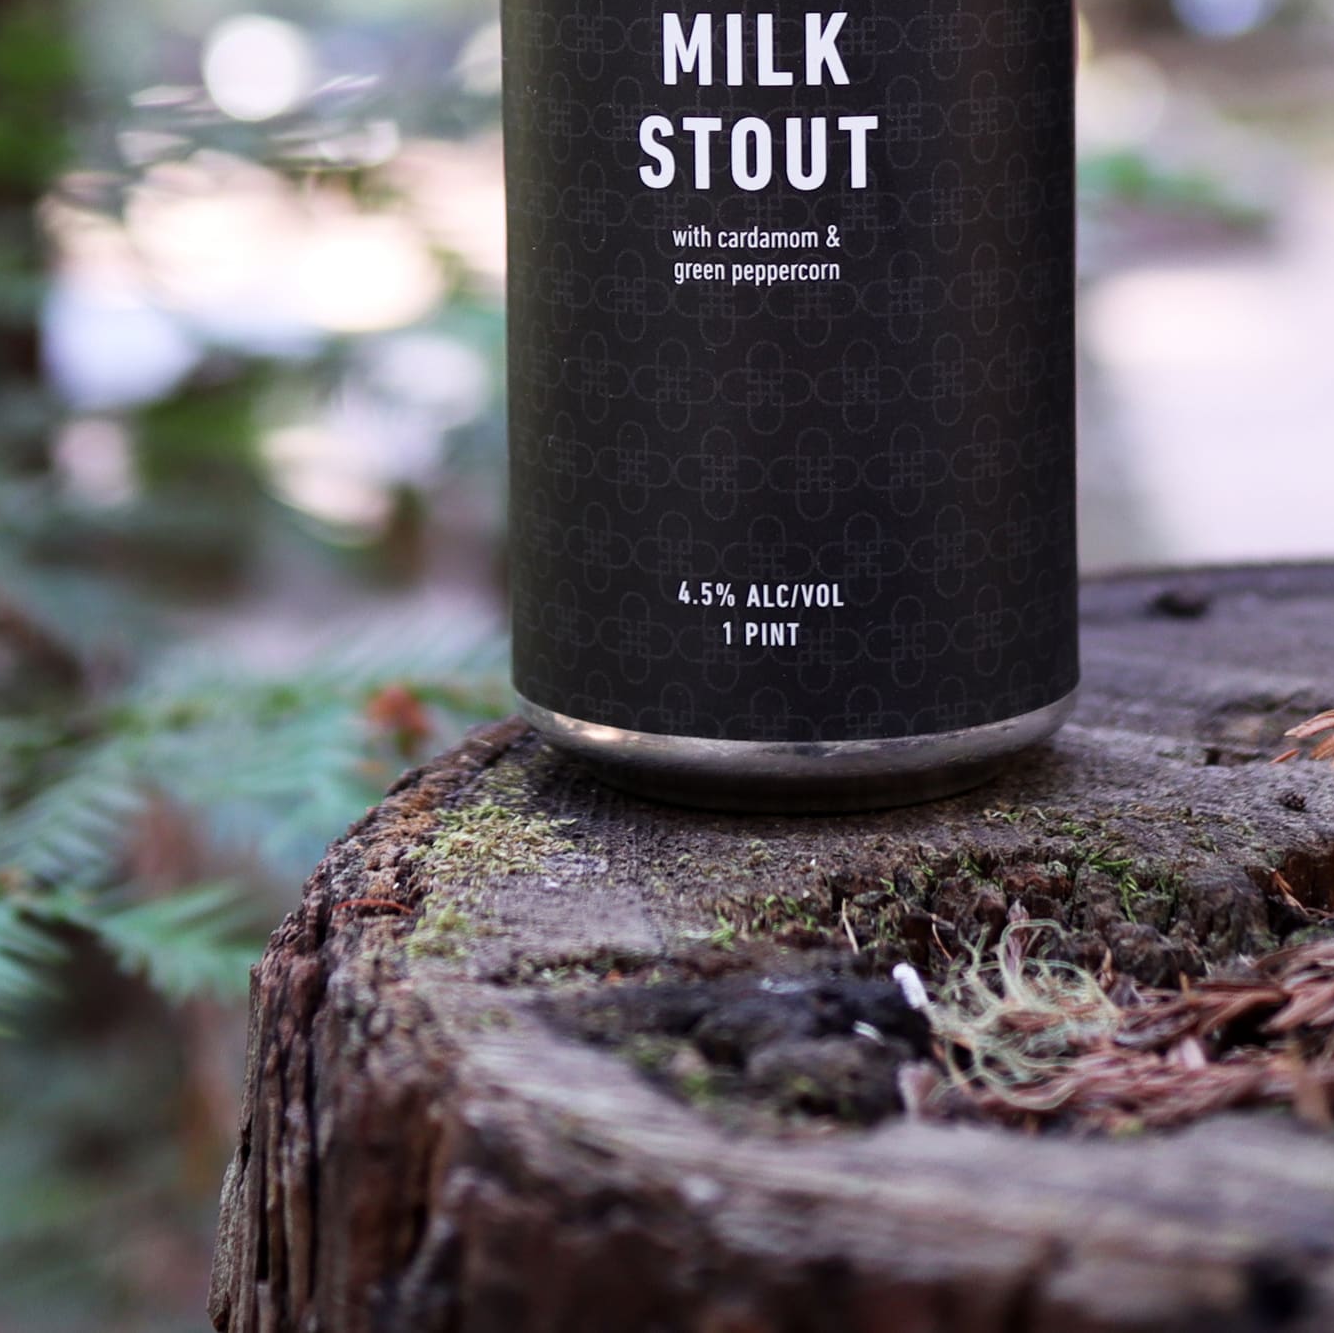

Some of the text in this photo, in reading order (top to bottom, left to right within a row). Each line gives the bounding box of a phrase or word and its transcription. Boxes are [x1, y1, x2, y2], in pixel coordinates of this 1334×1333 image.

[662, 11, 851, 87] MILK
[638, 114, 879, 192] STOUT
[672, 225, 841, 249] with cardamom &
[674, 262, 840, 287] green peppercorn
[678, 581, 845, 609] 4.5% ALC/VOL
[722, 621, 800, 647] 1 PINT
